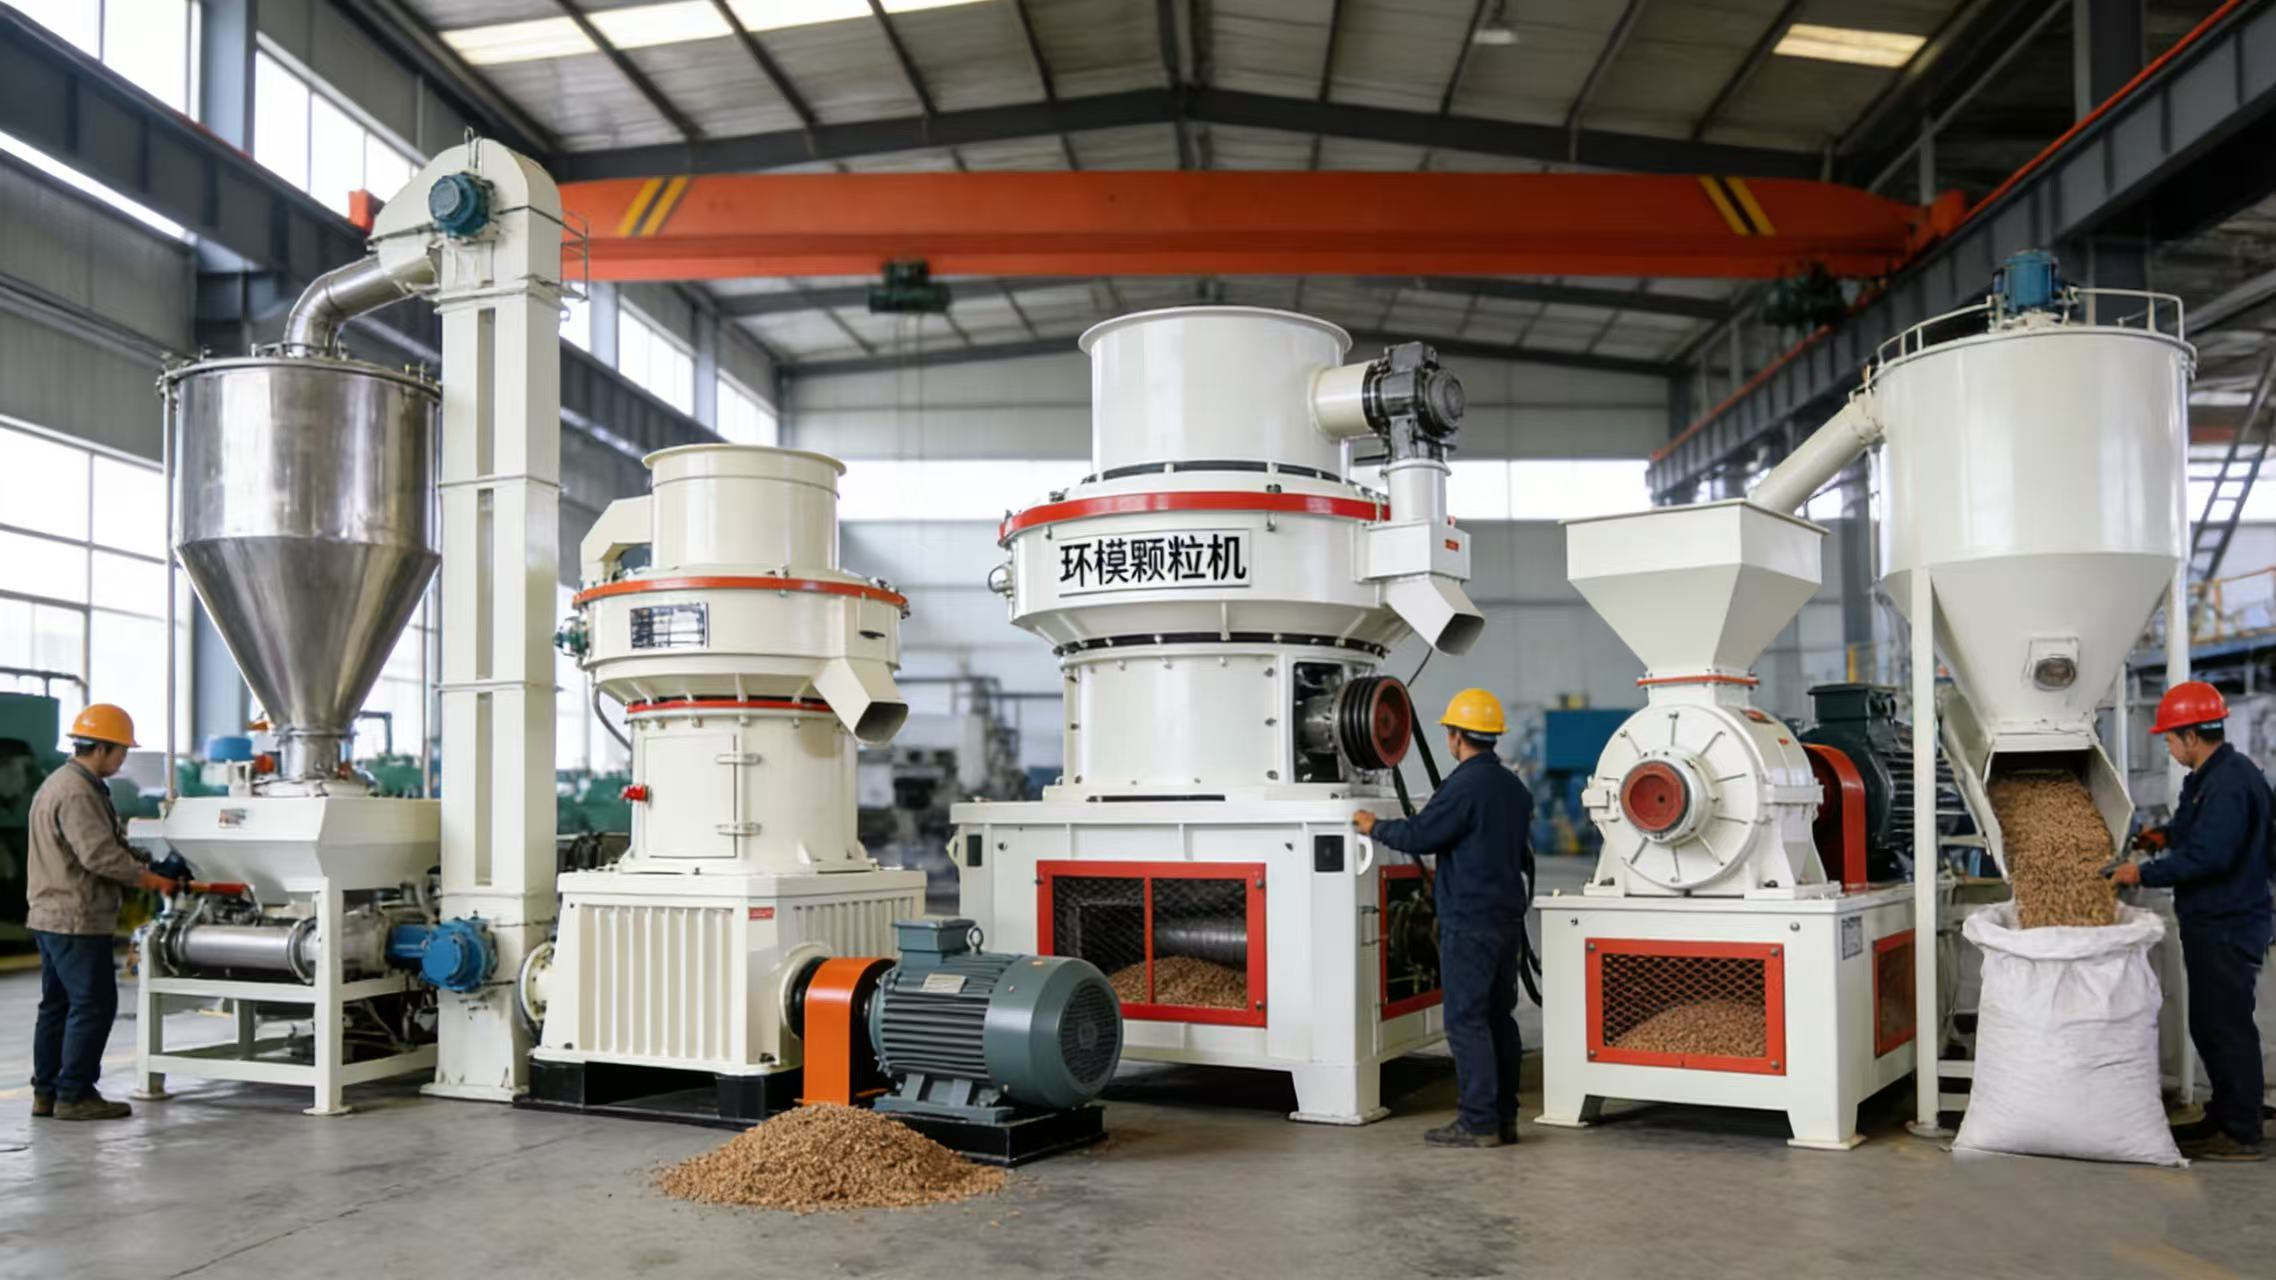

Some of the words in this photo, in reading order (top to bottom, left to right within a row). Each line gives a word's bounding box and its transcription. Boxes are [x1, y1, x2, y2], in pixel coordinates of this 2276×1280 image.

[1060, 534, 1247, 587] 环模颗粒机
